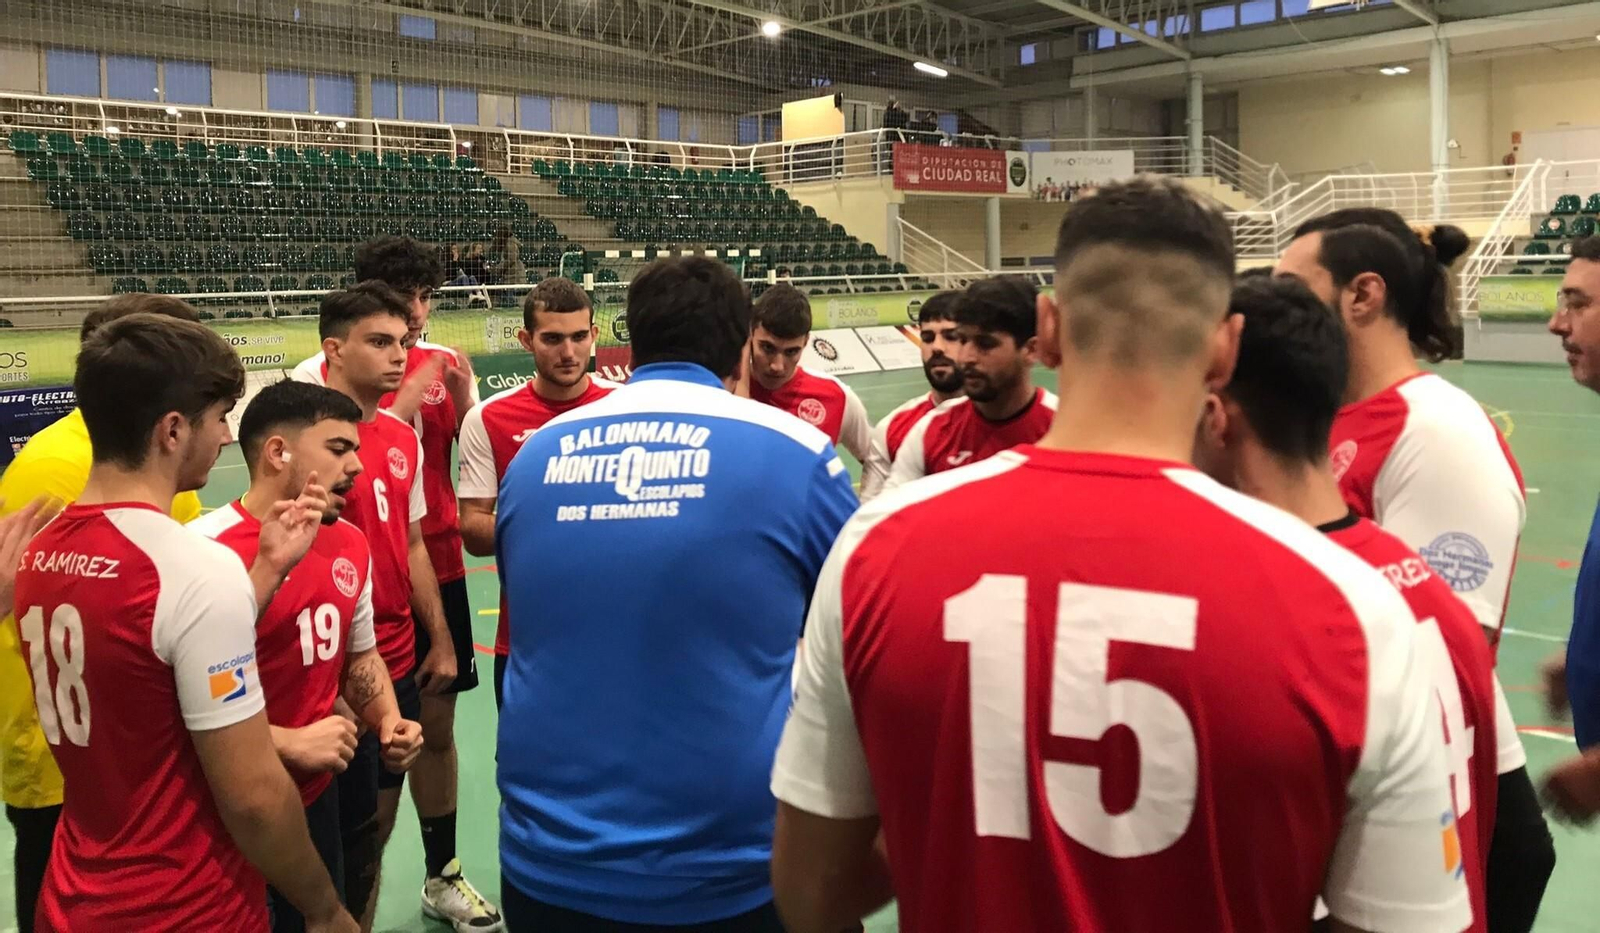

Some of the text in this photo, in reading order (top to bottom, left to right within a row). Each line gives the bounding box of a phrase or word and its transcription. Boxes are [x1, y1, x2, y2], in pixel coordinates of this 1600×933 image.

[922, 167, 1002, 183] CIUDAD REAL
[265, 335, 284, 344] vive
[0, 371, 29, 382] ORTES
[560, 421, 711, 456] BALONMANO
[543, 446, 711, 502] MONTEQUINTO
[372, 477, 390, 523] 6
[640, 483, 705, 500] ESCOLAPIOS
[556, 501, 679, 521] DOS HERMANAS
[32, 550, 120, 578] RAMIREZ
[295, 602, 341, 667] 19
[20, 603, 91, 747] 18
[943, 573, 1198, 858] 15
